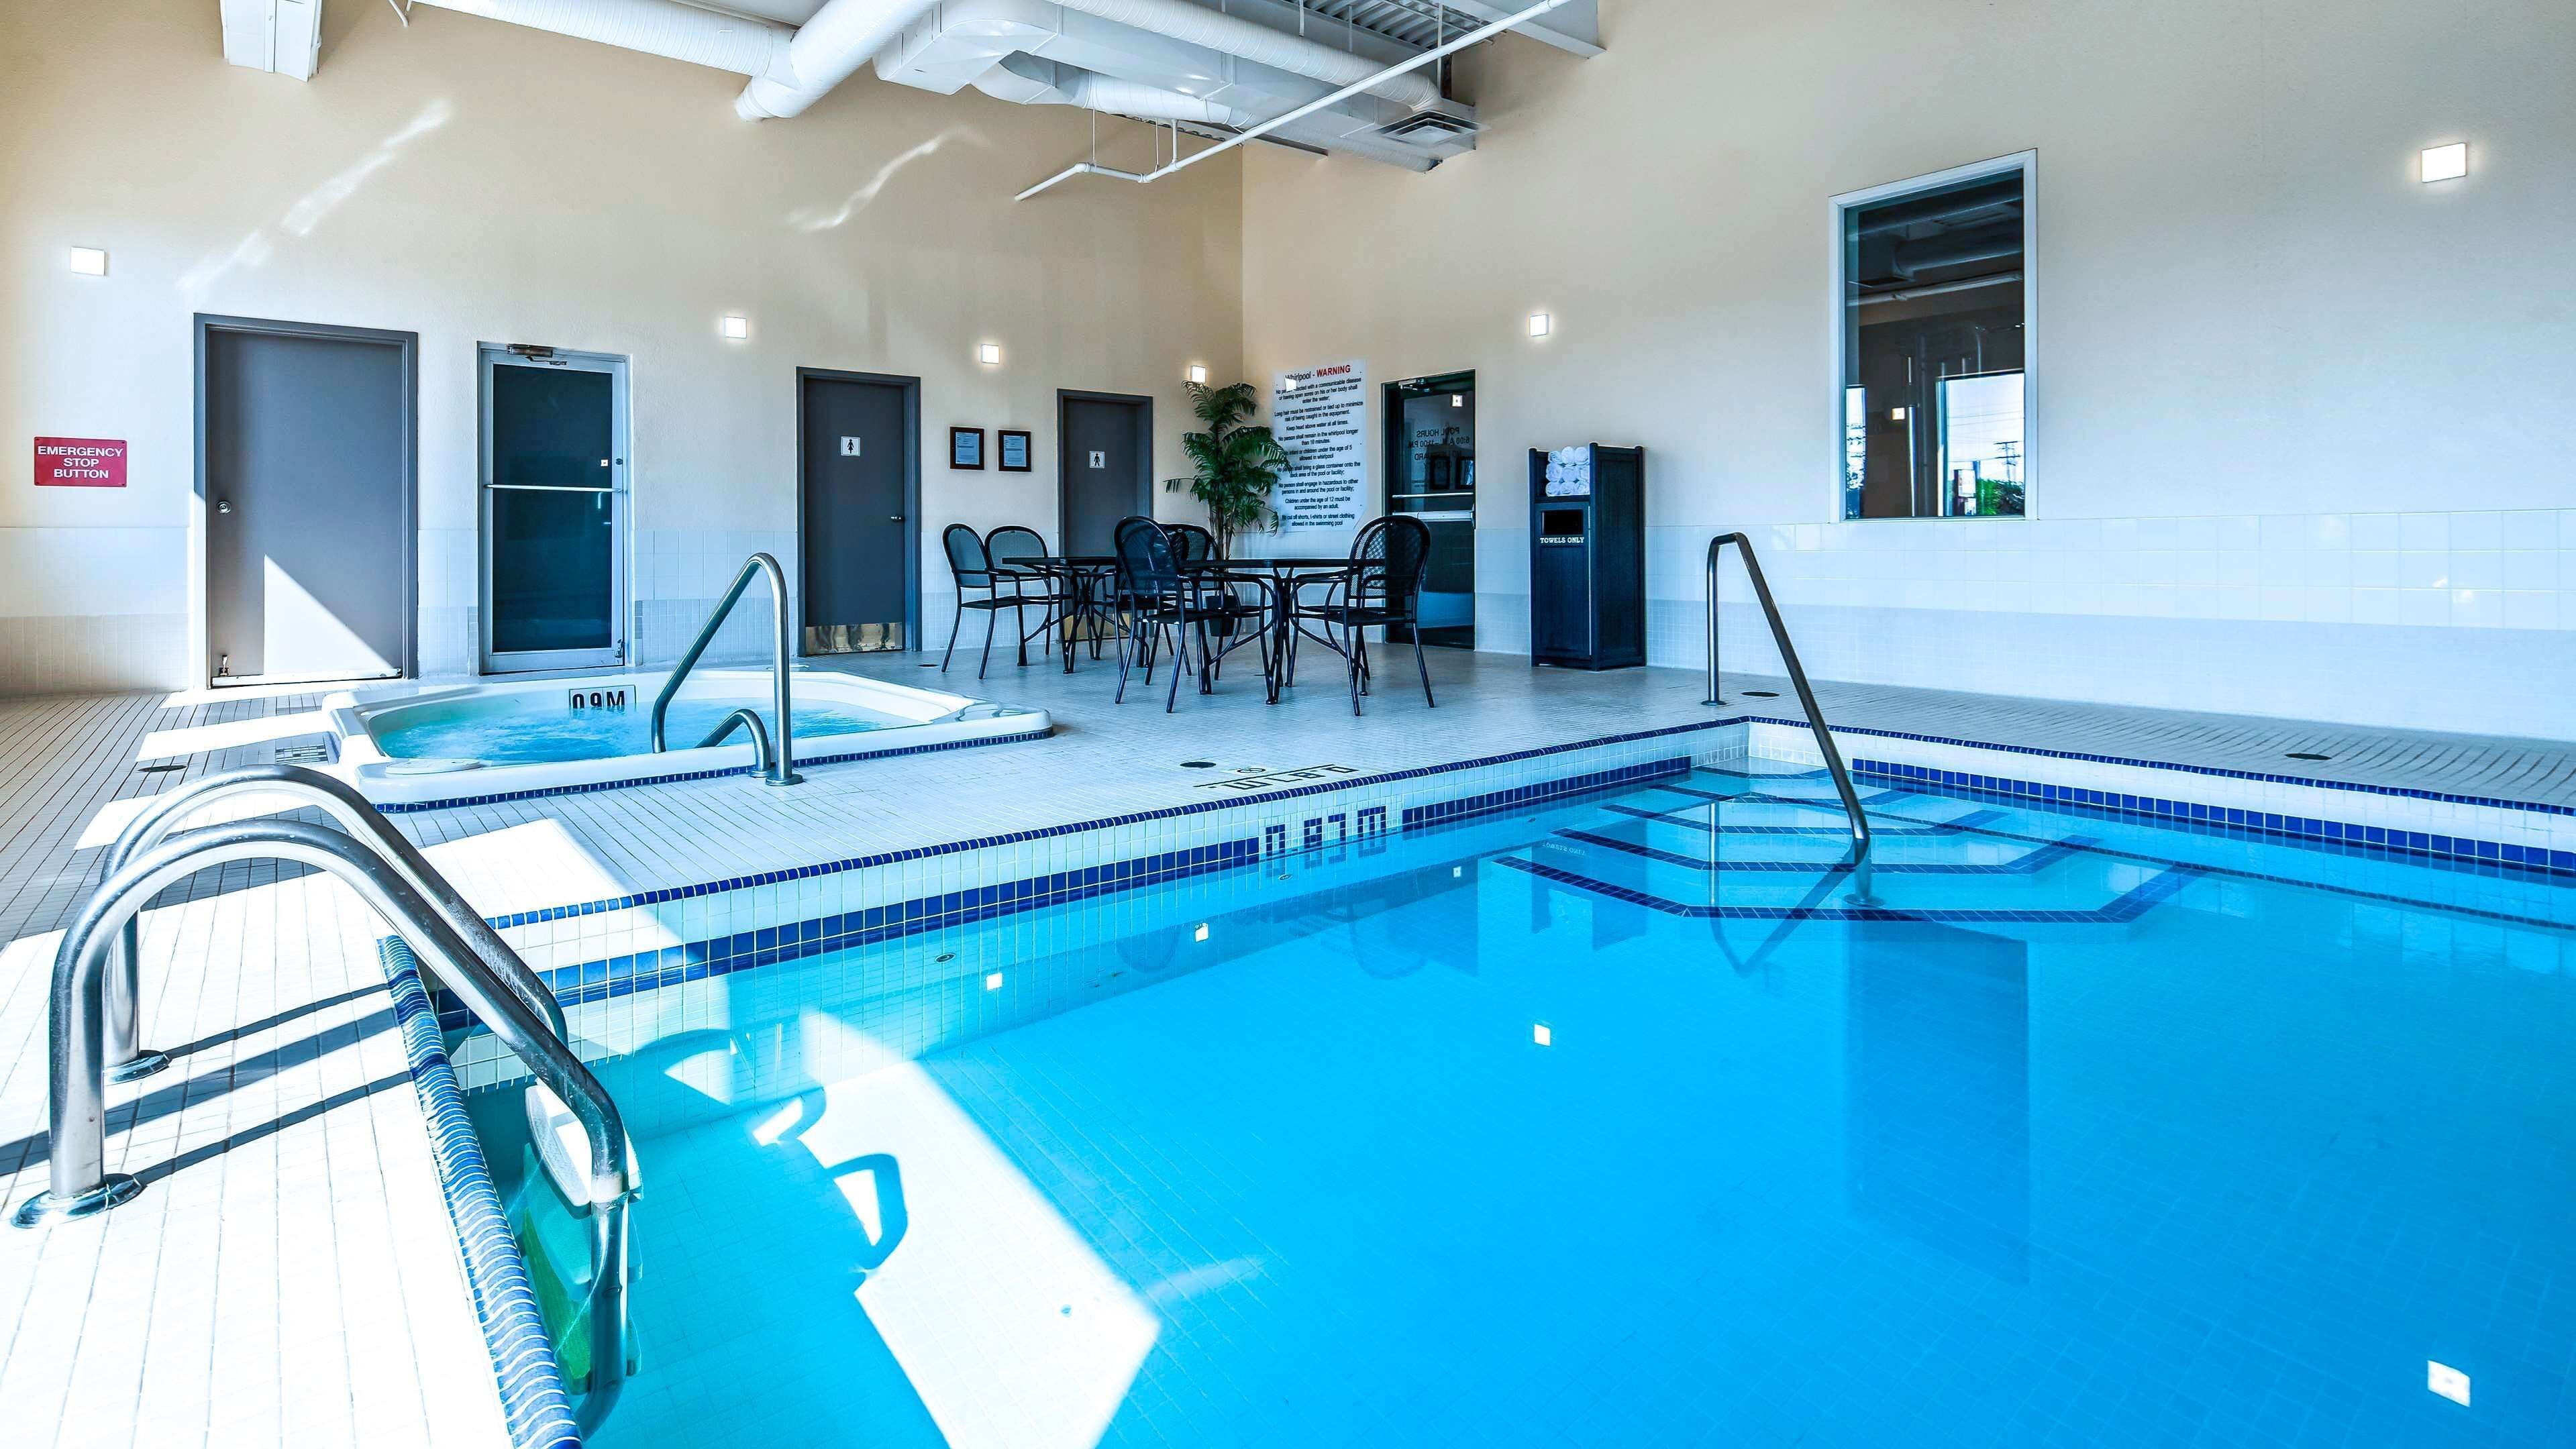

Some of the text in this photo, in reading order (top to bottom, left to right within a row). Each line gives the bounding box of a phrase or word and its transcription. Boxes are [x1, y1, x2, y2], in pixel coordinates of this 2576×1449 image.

[1317, 365, 1351, 378] WARNING
[1319, 380, 1345, 388] communicable
[1328, 429, 1345, 437] whirlpool
[38, 445, 123, 458] EMERGENCY
[63, 458, 99, 468] STOP
[54, 468, 109, 479] BUTTON
